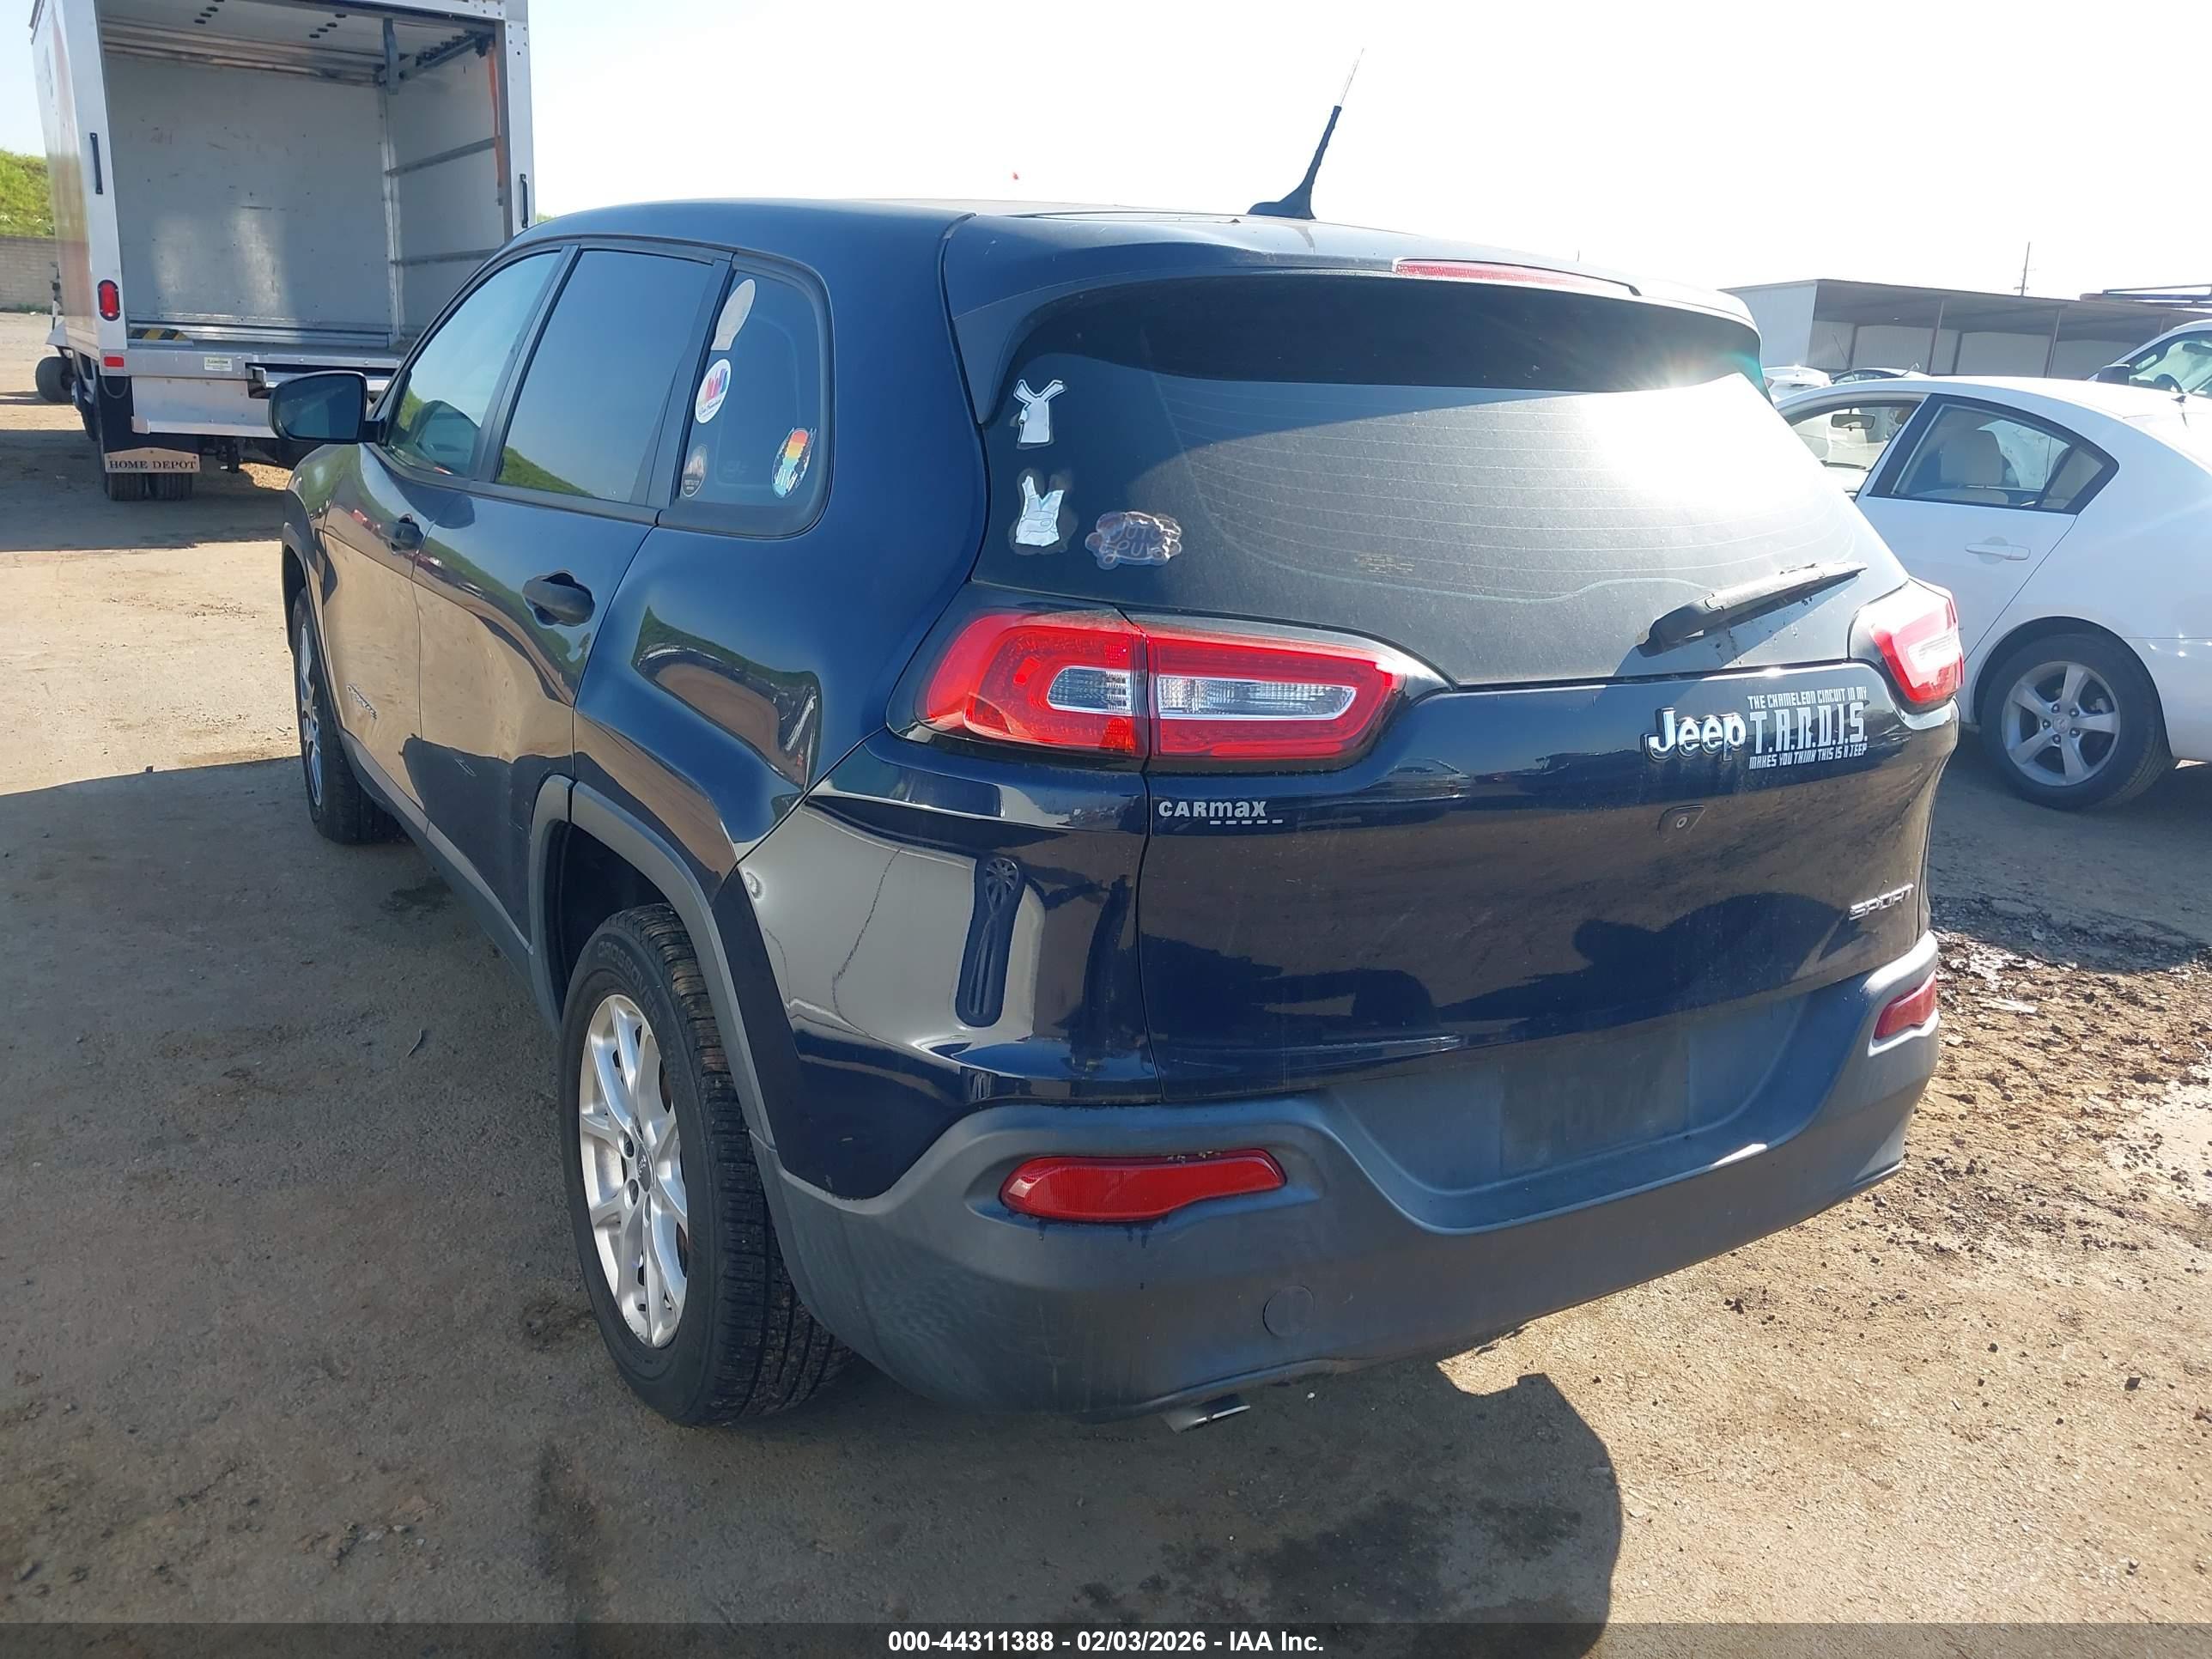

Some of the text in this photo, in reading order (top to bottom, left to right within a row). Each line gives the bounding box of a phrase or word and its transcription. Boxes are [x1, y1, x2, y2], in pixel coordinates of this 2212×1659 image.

[109, 460, 197, 469] HOME DEPOT
[1747, 695, 1766, 709] THE
[1767, 690, 1816, 708] CHAMELEON
[1816, 688, 1845, 704] CIRCUIT
[1856, 686, 1867, 700] MY
[1641, 707, 1747, 761] Jeep
[1749, 702, 1869, 754] T.A.R.D.I.S.
[1749, 742, 1868, 769] MAKES YOU THINK THIS IS A JEEP
[1848, 883, 1914, 921] SPORT
[597, 941, 661, 1024] CROSSOVER
